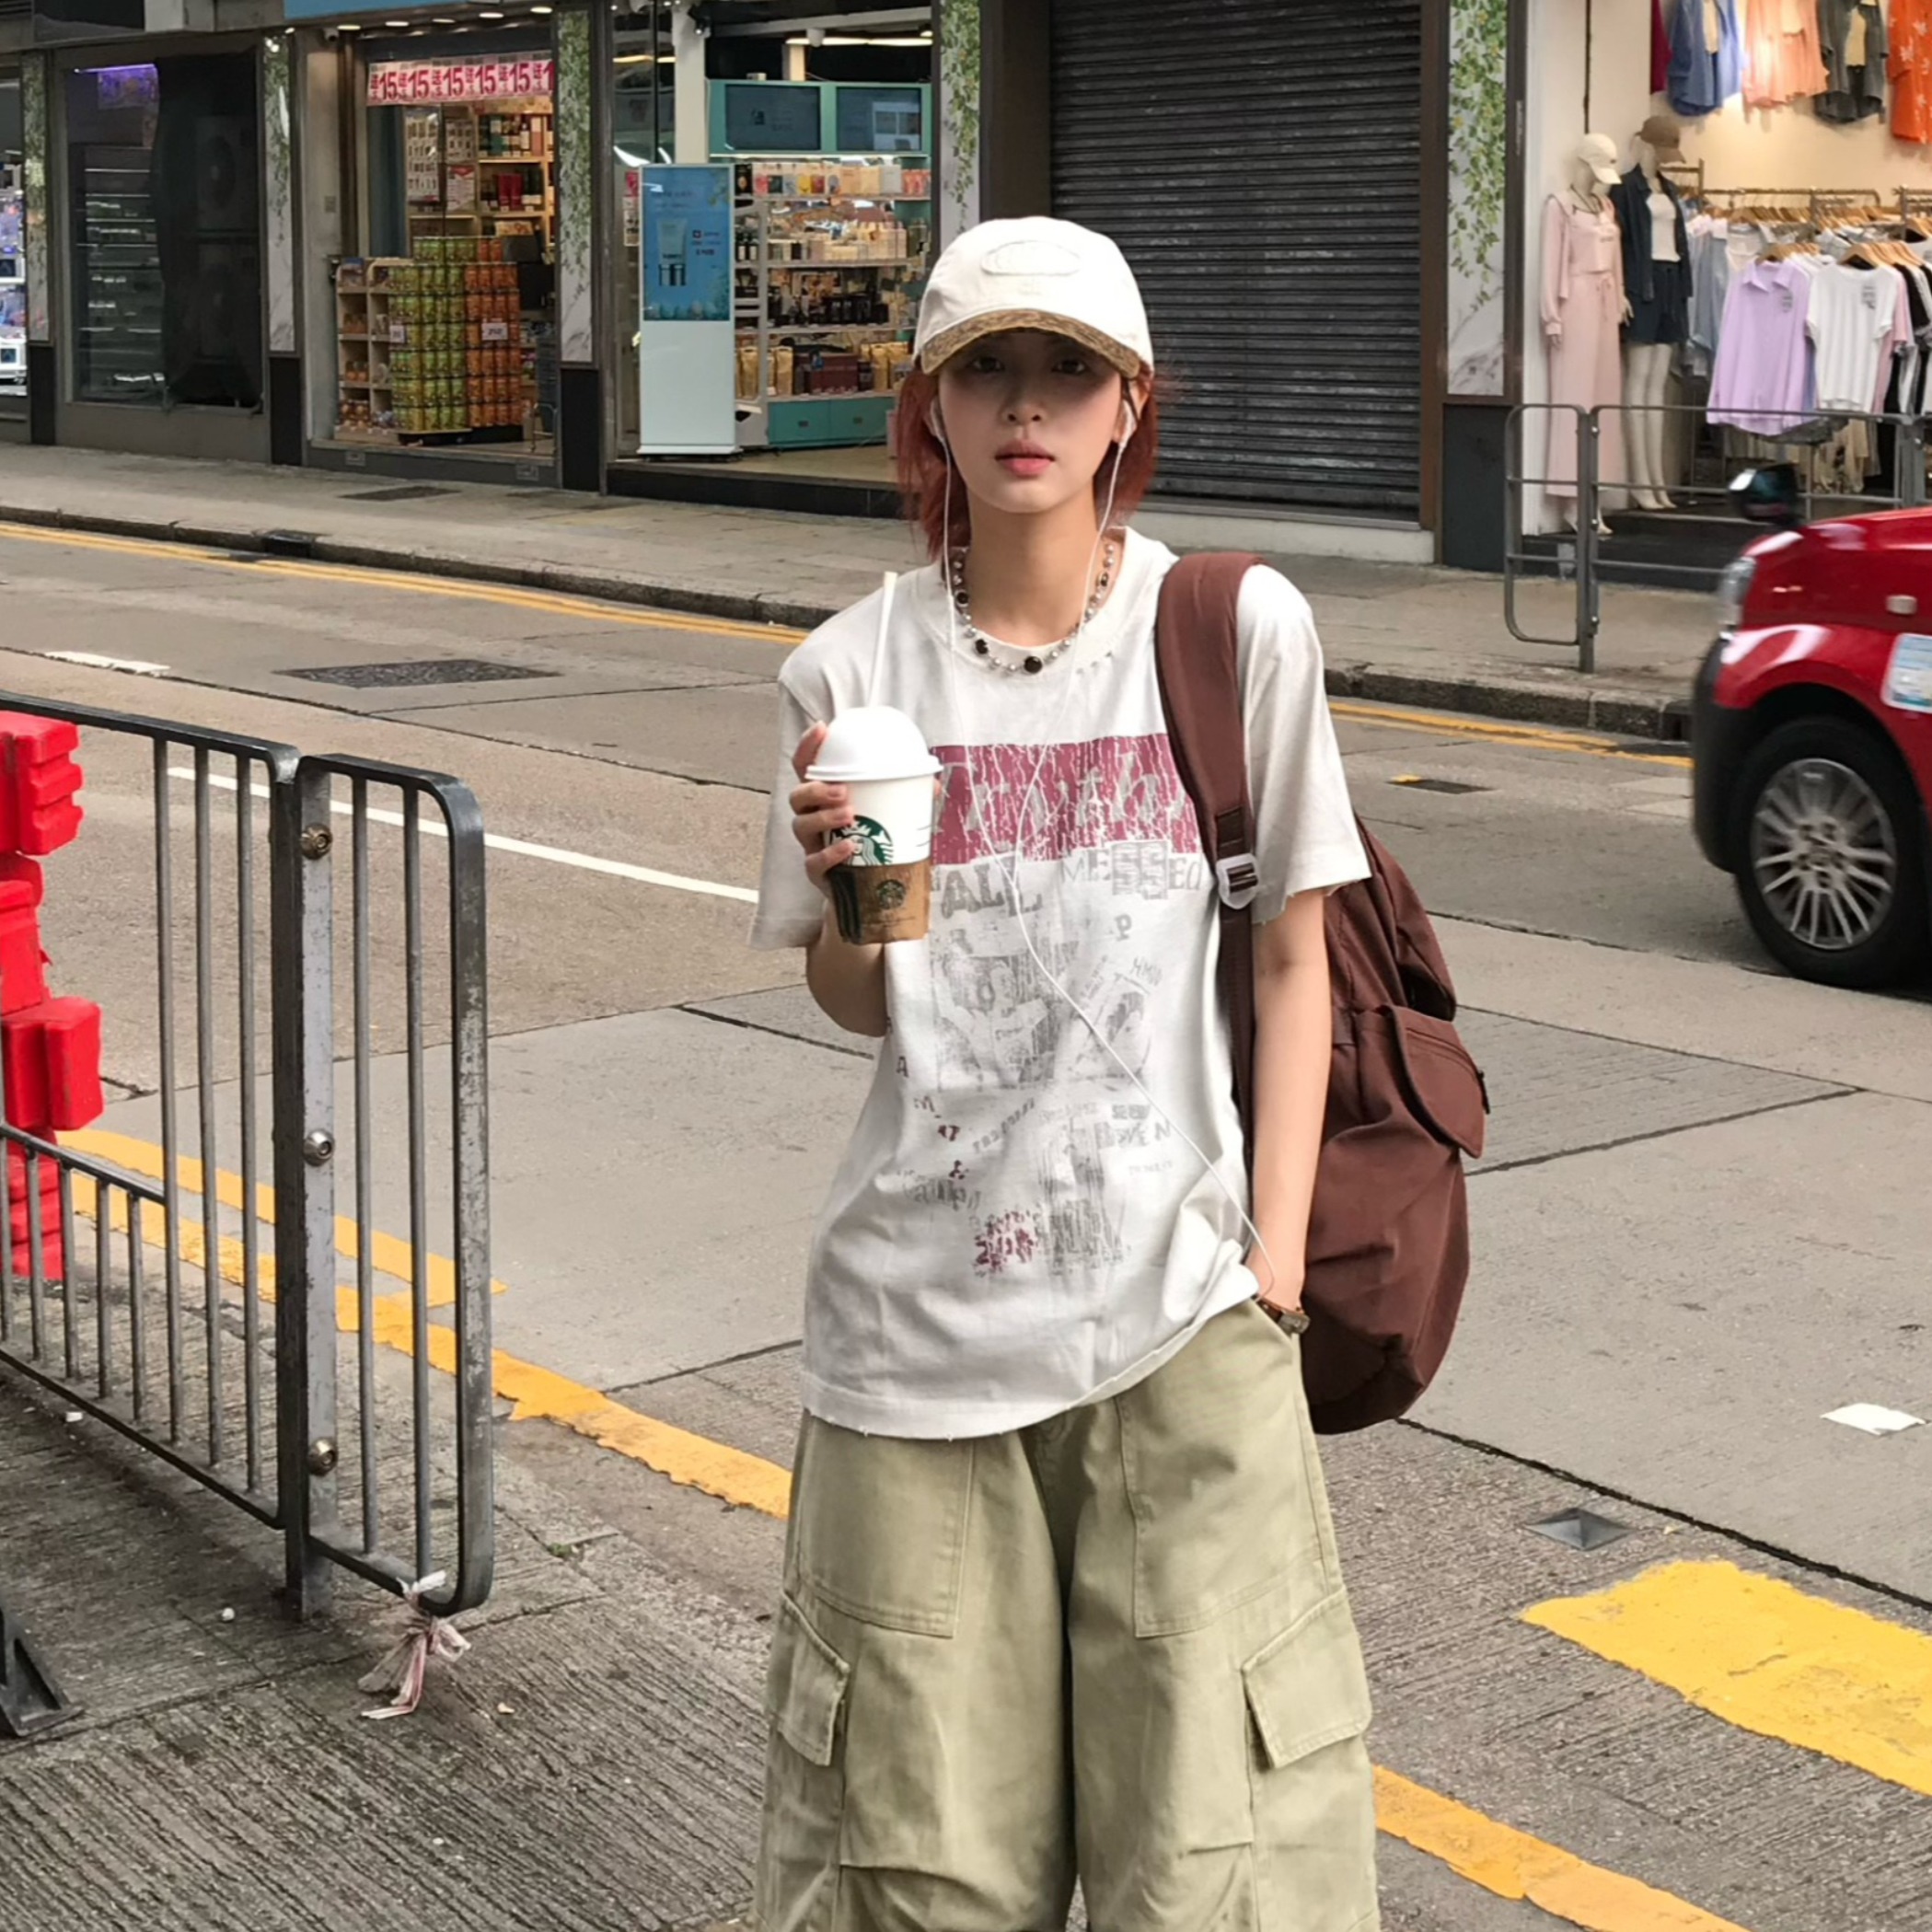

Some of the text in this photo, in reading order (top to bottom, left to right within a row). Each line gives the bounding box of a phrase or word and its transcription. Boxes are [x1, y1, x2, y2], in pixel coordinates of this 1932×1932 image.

[379, 73, 398, 100] 15
[408, 70, 430, 98] 15
[443, 66, 464, 98] 15
[475, 64, 496, 95] 15
[509, 63, 530, 93] 15
